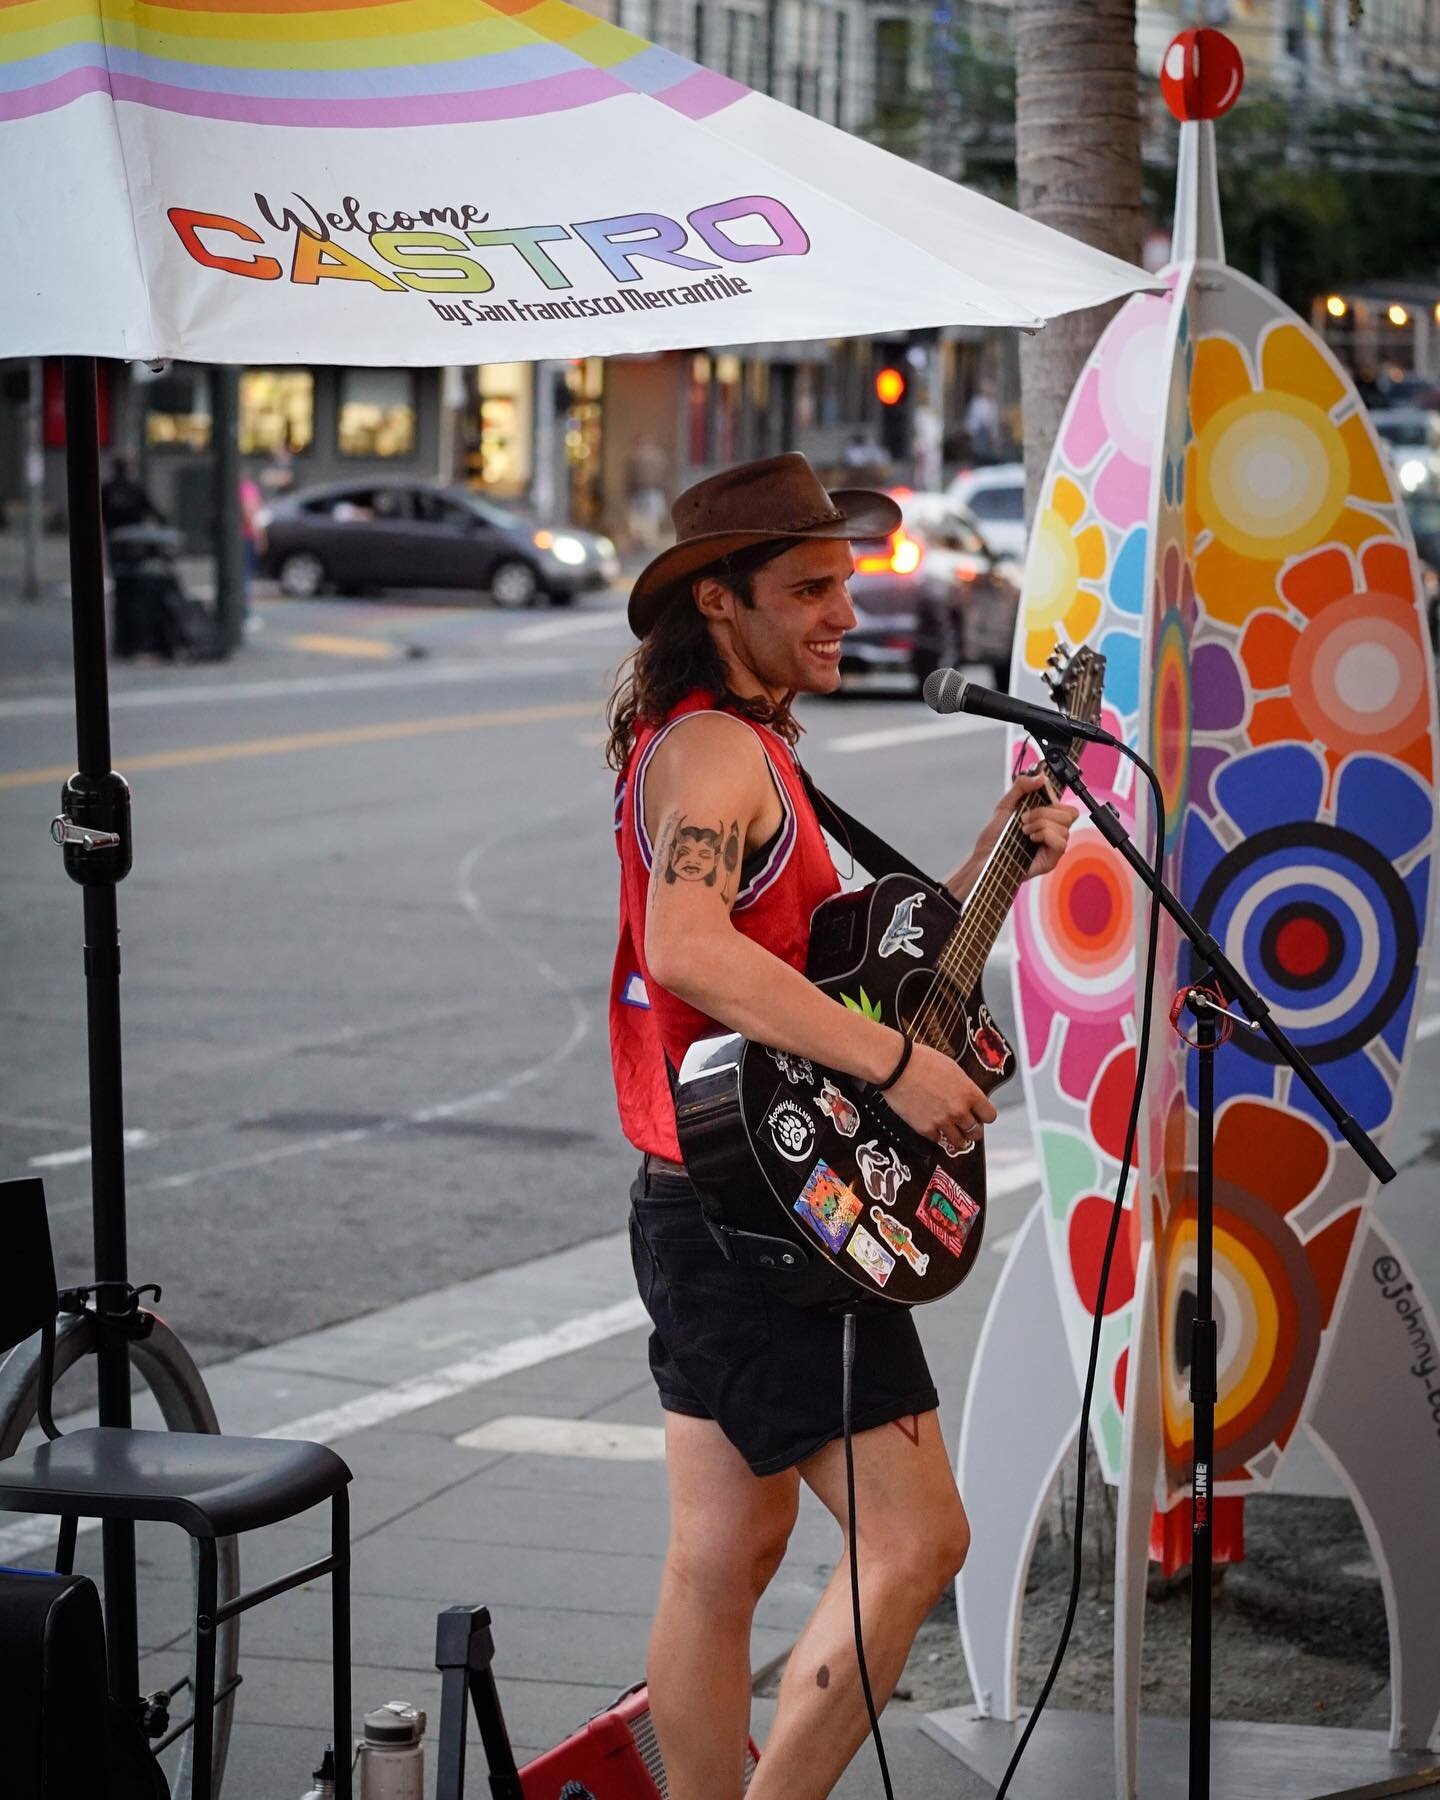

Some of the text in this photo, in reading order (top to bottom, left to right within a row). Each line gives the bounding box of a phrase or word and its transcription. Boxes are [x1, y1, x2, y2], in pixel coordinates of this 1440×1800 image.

[167, 195, 811, 293] CASTRO
[254, 192, 489, 243] Welcome
[427, 273, 753, 326] by San Francisco Mercantile
